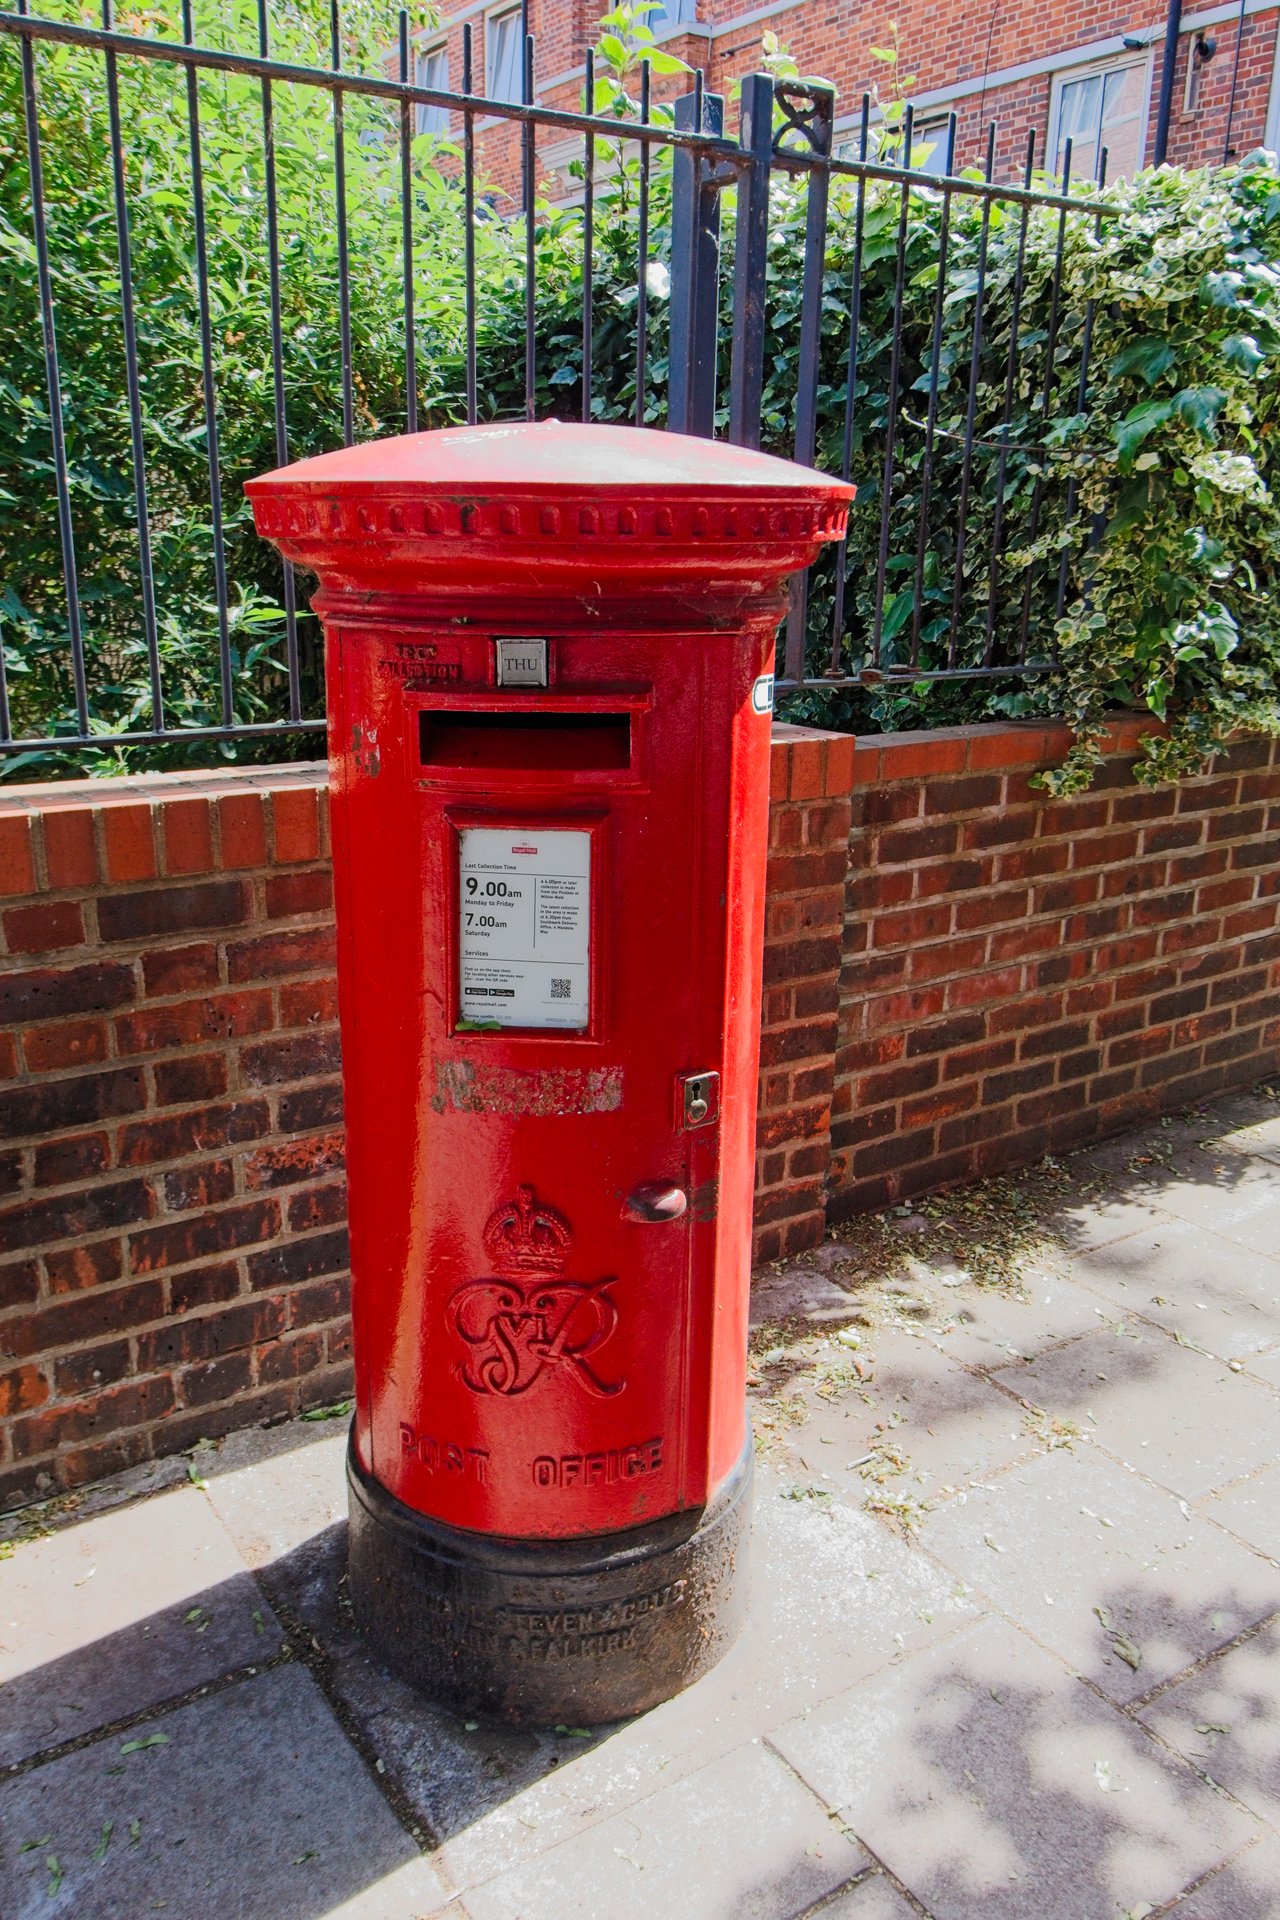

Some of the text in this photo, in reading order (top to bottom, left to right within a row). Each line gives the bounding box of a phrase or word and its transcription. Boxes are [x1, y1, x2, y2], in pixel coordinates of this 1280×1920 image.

[504, 658, 538, 671] THU
[466, 877, 522, 898] 9.00am
[465, 899, 487, 907] Monday
[496, 900, 515, 908] Friday
[465, 913, 507, 928] 7.00am
[465, 929, 491, 937] Saturday
[465, 949, 489, 957] Services
[399, 1421, 664, 1488] POST OFFICE
[498, 1608, 593, 1633] STEVEN
[530, 1627, 636, 1659] FALKIRK
